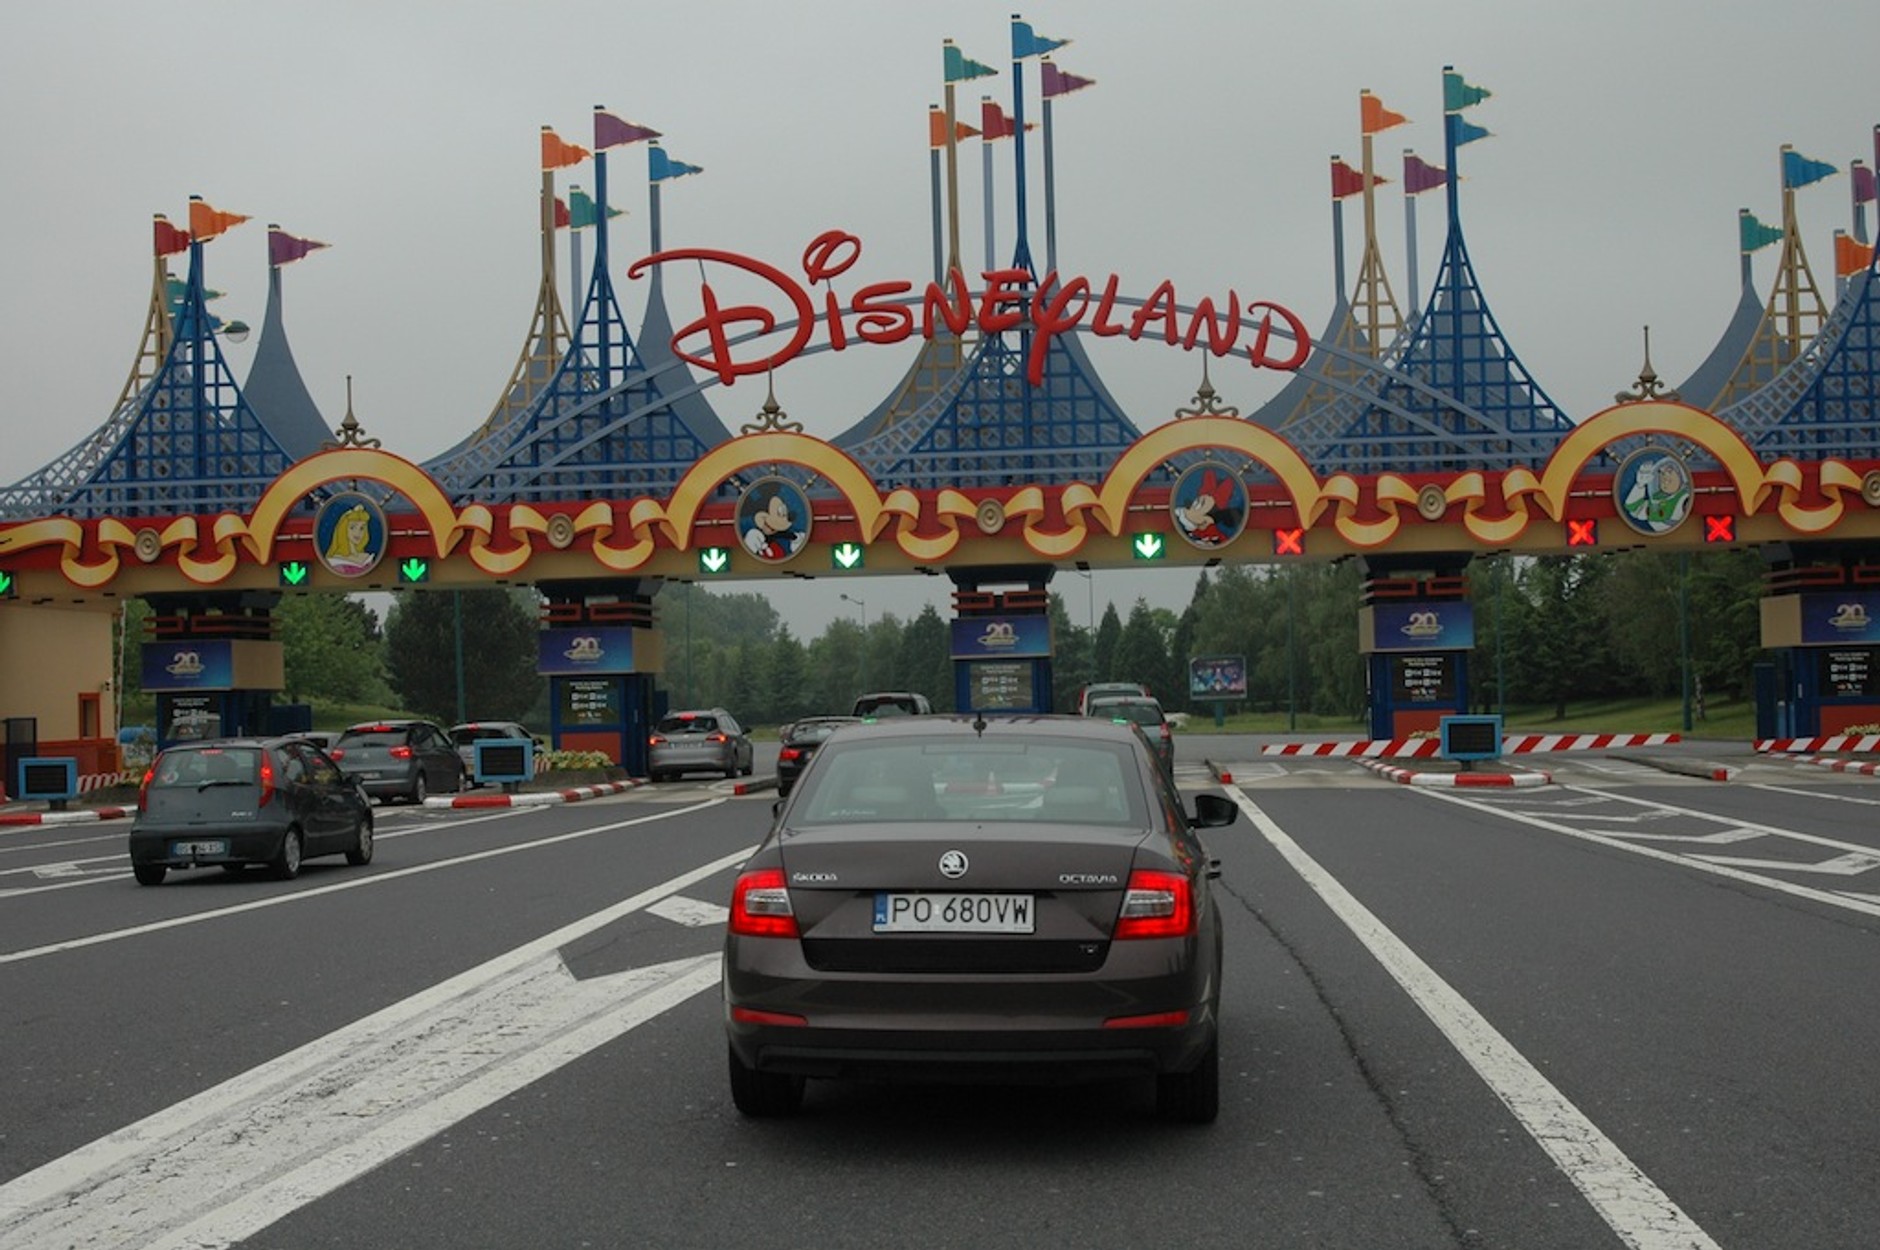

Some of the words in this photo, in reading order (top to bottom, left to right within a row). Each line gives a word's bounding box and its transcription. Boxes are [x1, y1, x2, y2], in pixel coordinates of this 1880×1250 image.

[1409, 612, 1438, 629] 20
[1837, 604, 1864, 621] 20
[986, 623, 1012, 638] 20
[572, 637, 598, 653] 20
[174, 652, 199, 668] 20
[1059, 874, 1118, 884] OCTAVIA
[892, 897, 931, 923] PO
[942, 897, 1029, 924] 680VW
